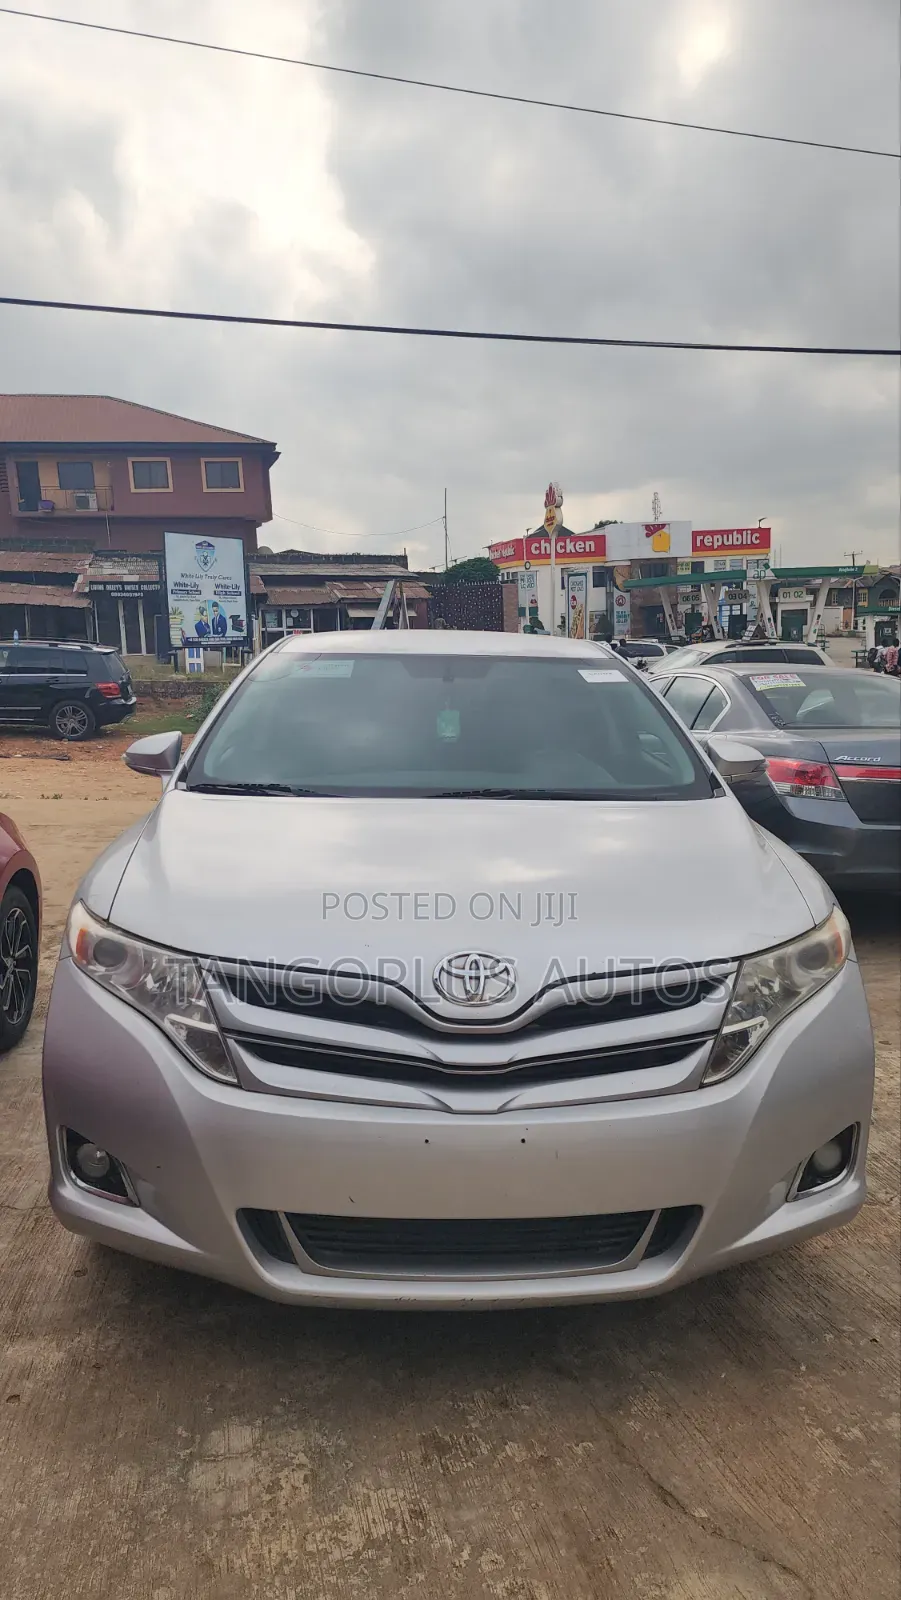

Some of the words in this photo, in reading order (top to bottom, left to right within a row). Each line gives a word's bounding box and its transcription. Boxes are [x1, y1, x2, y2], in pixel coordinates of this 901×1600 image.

[696, 530, 760, 549] republic
[531, 539, 595, 555] chcken
[173, 581, 199, 590] White-Lily
[215, 583, 240, 591] White-Lily
[793, 591, 804, 599] 02
